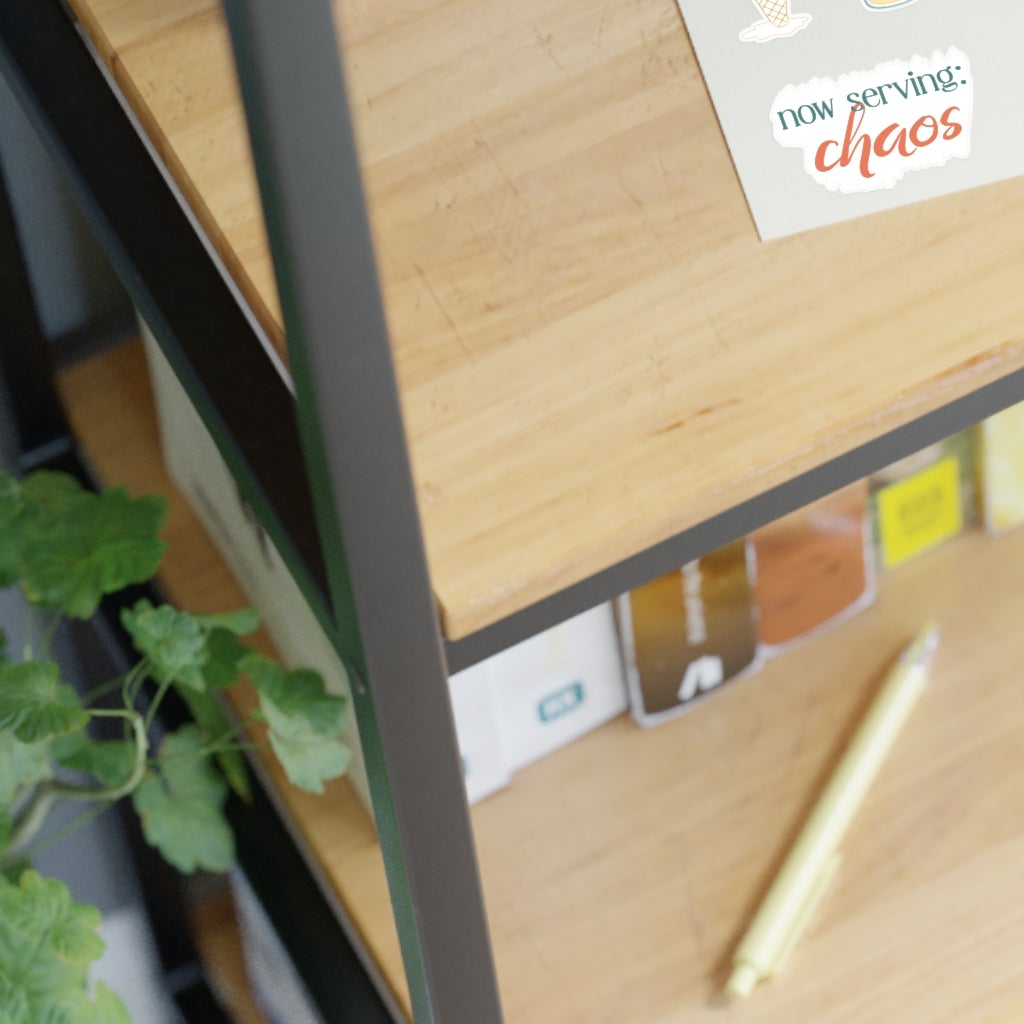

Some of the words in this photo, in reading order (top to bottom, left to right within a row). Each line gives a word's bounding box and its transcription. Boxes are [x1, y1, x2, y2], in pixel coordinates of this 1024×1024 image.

[776, 97, 835, 131] now
[846, 65, 967, 112] serving:
[814, 101, 962, 179] chaos
